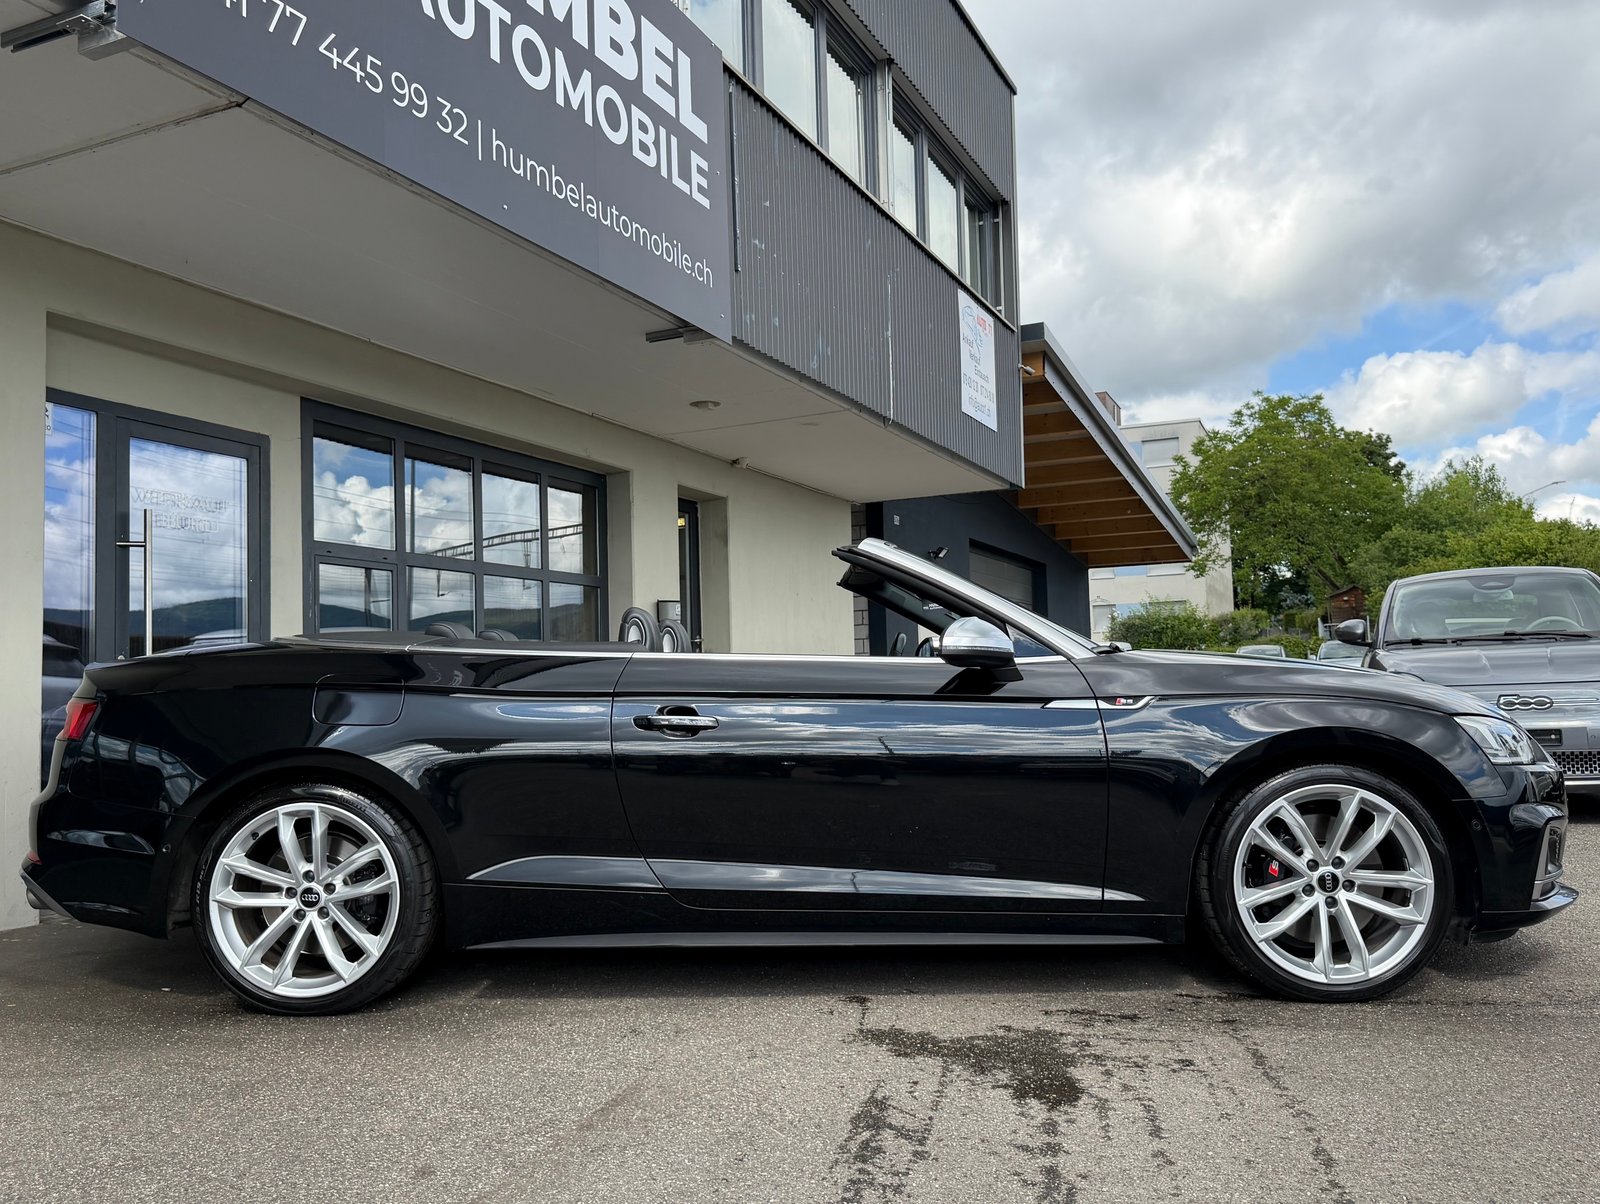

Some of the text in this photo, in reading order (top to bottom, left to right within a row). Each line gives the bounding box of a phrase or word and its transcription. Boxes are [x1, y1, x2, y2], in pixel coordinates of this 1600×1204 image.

[318, 33, 383, 94] 445
[391, 71, 428, 118] 99
[436, 96, 469, 145] 32
[492, 128, 713, 288] humbelautomobile.ch
[418, 0, 710, 210] UTOMOBILE
[1498, 694, 1553, 711] 500
